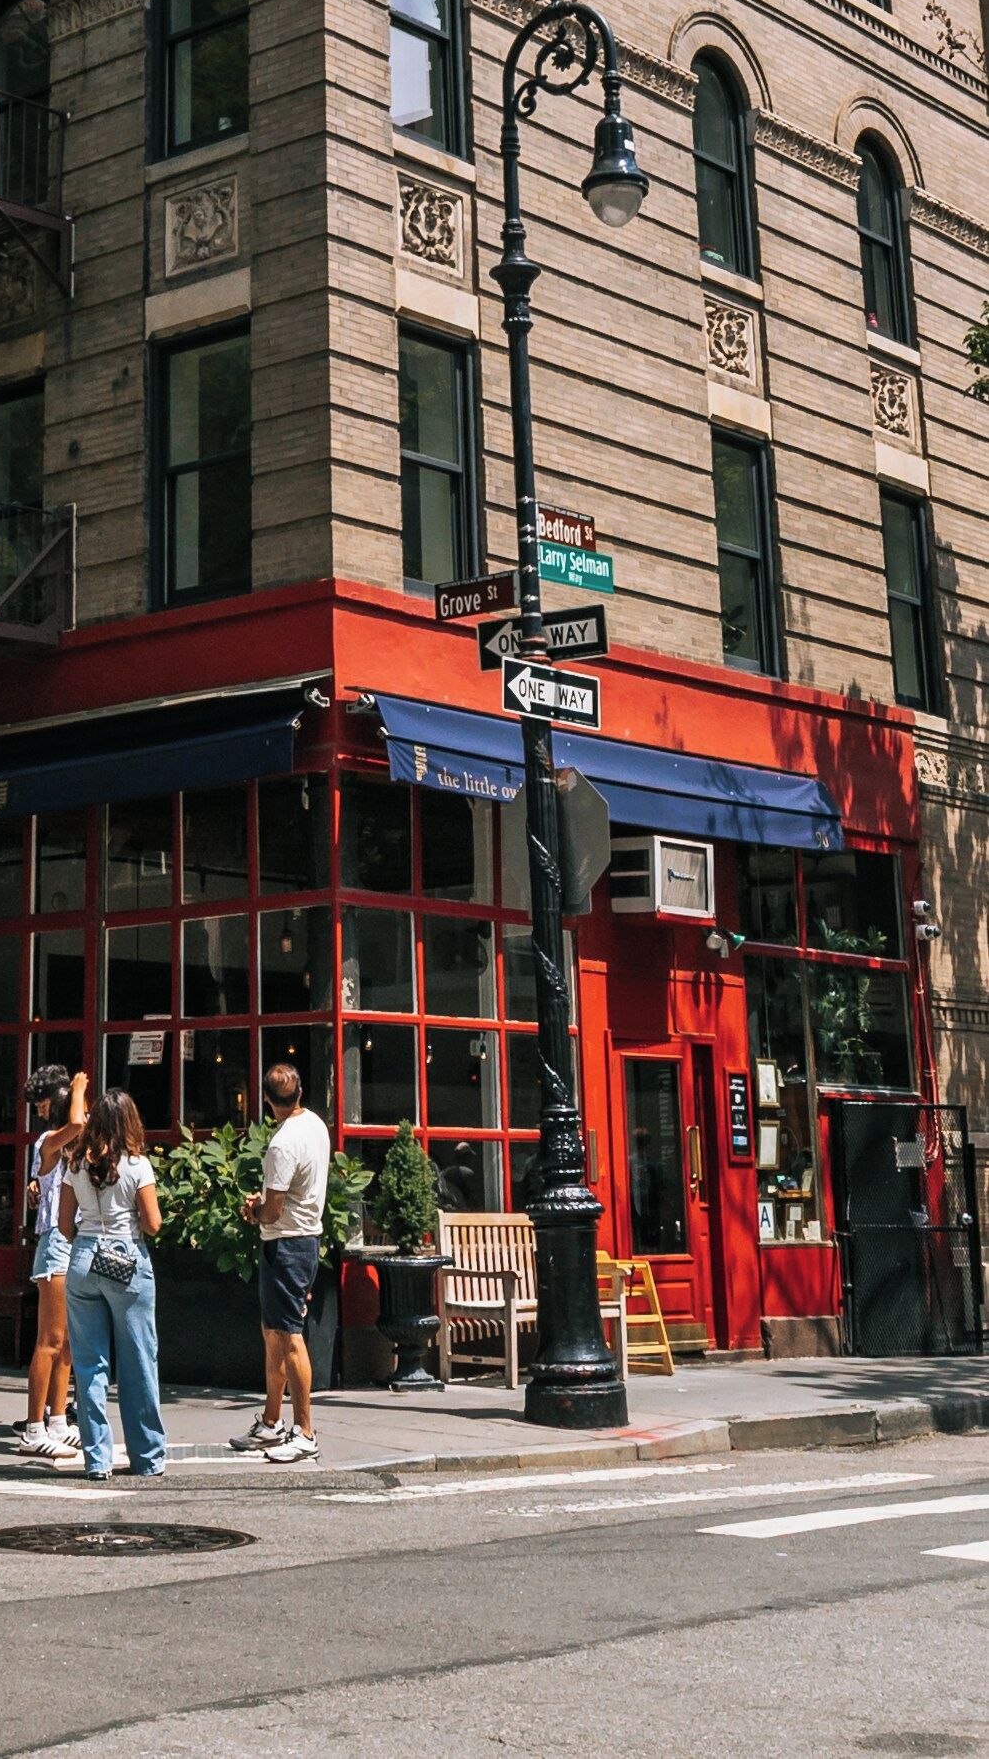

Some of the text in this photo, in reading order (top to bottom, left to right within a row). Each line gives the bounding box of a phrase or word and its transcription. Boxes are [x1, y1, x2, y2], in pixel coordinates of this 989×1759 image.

[539, 513, 593, 546] Bedford St
[540, 545, 609, 577] Larry Selman
[568, 572, 583, 585] Way
[440, 584, 498, 617] Grove St
[499, 622, 589, 653] ON WAY
[518, 678, 587, 710] ONE WAY
[437, 766, 460, 789] the
[463, 771, 498, 797] little
[761, 1205, 771, 1228] A
